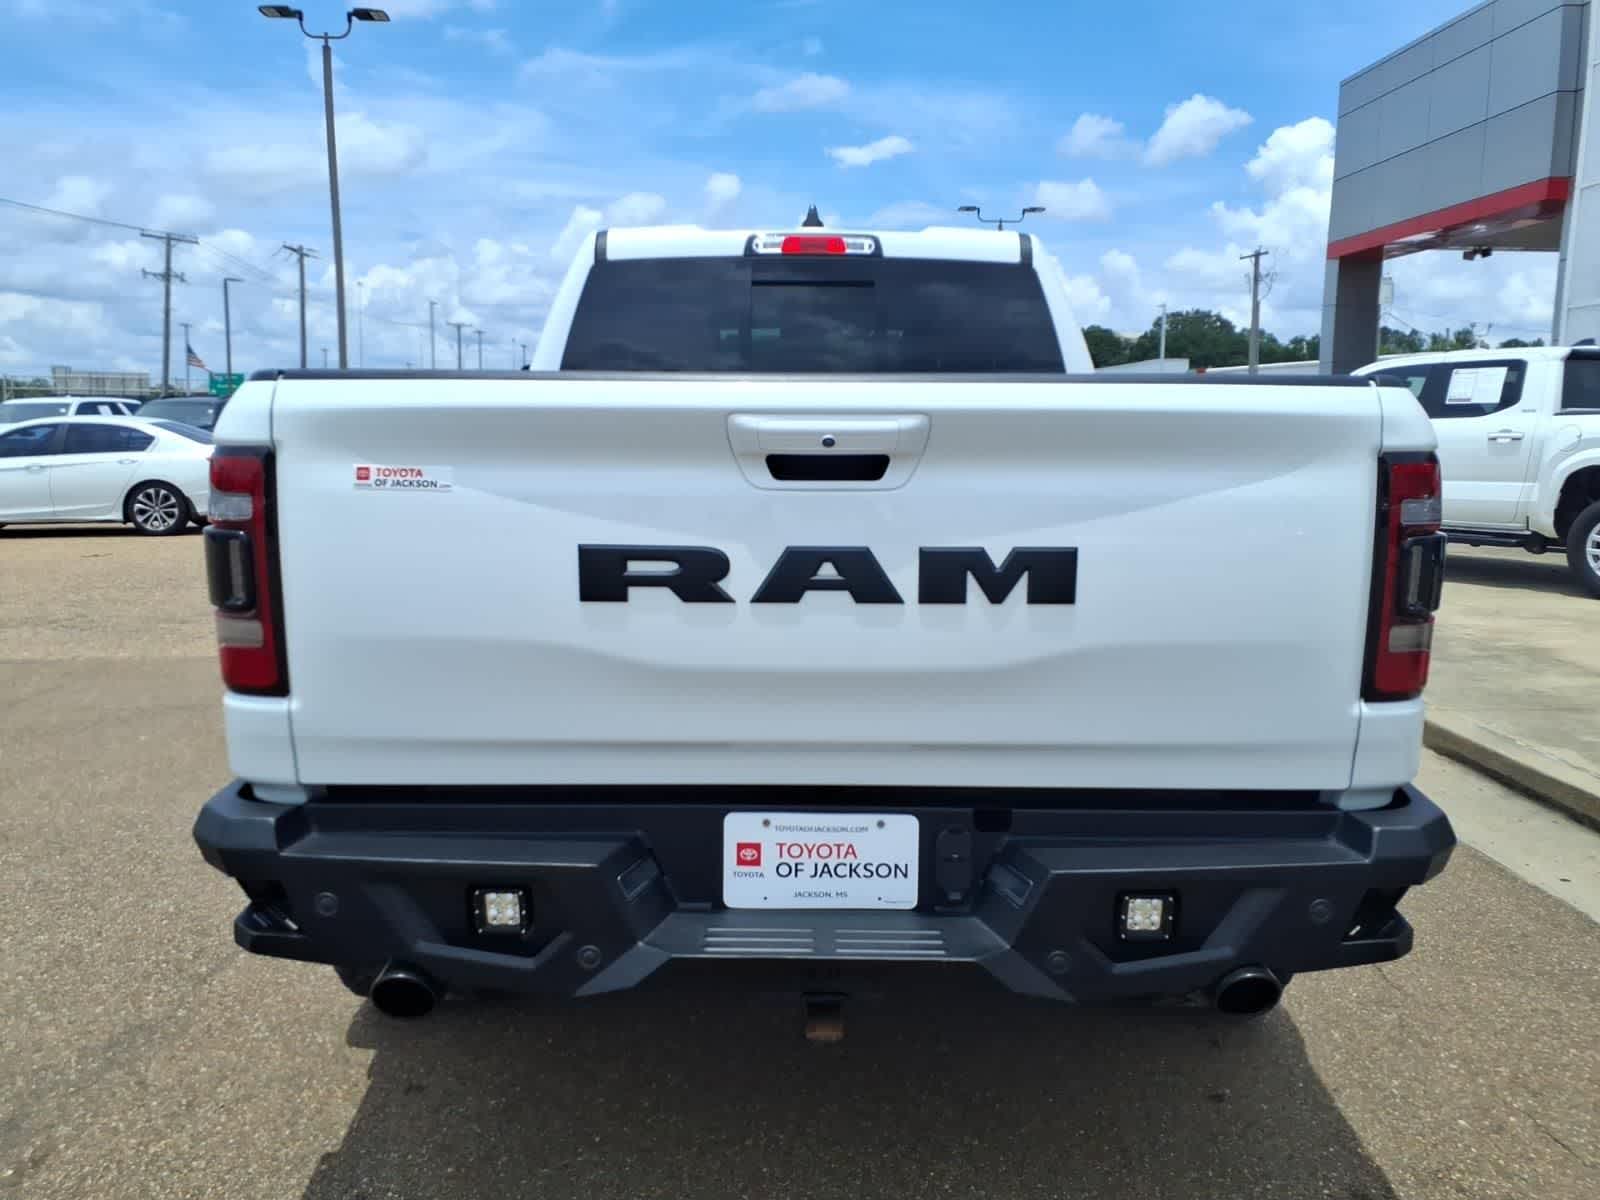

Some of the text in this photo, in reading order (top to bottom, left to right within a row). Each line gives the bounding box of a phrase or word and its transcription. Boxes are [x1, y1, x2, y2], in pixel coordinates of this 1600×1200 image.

[375, 467, 423, 478] TOYOTA
[374, 479, 388, 487] OF
[391, 479, 438, 489] JACKSON
[578, 544, 1078, 605] RAM
[776, 843, 858, 860] TOYOTA
[733, 871, 765, 879] TOYOTA
[775, 861, 909, 879] OF JACKSON
